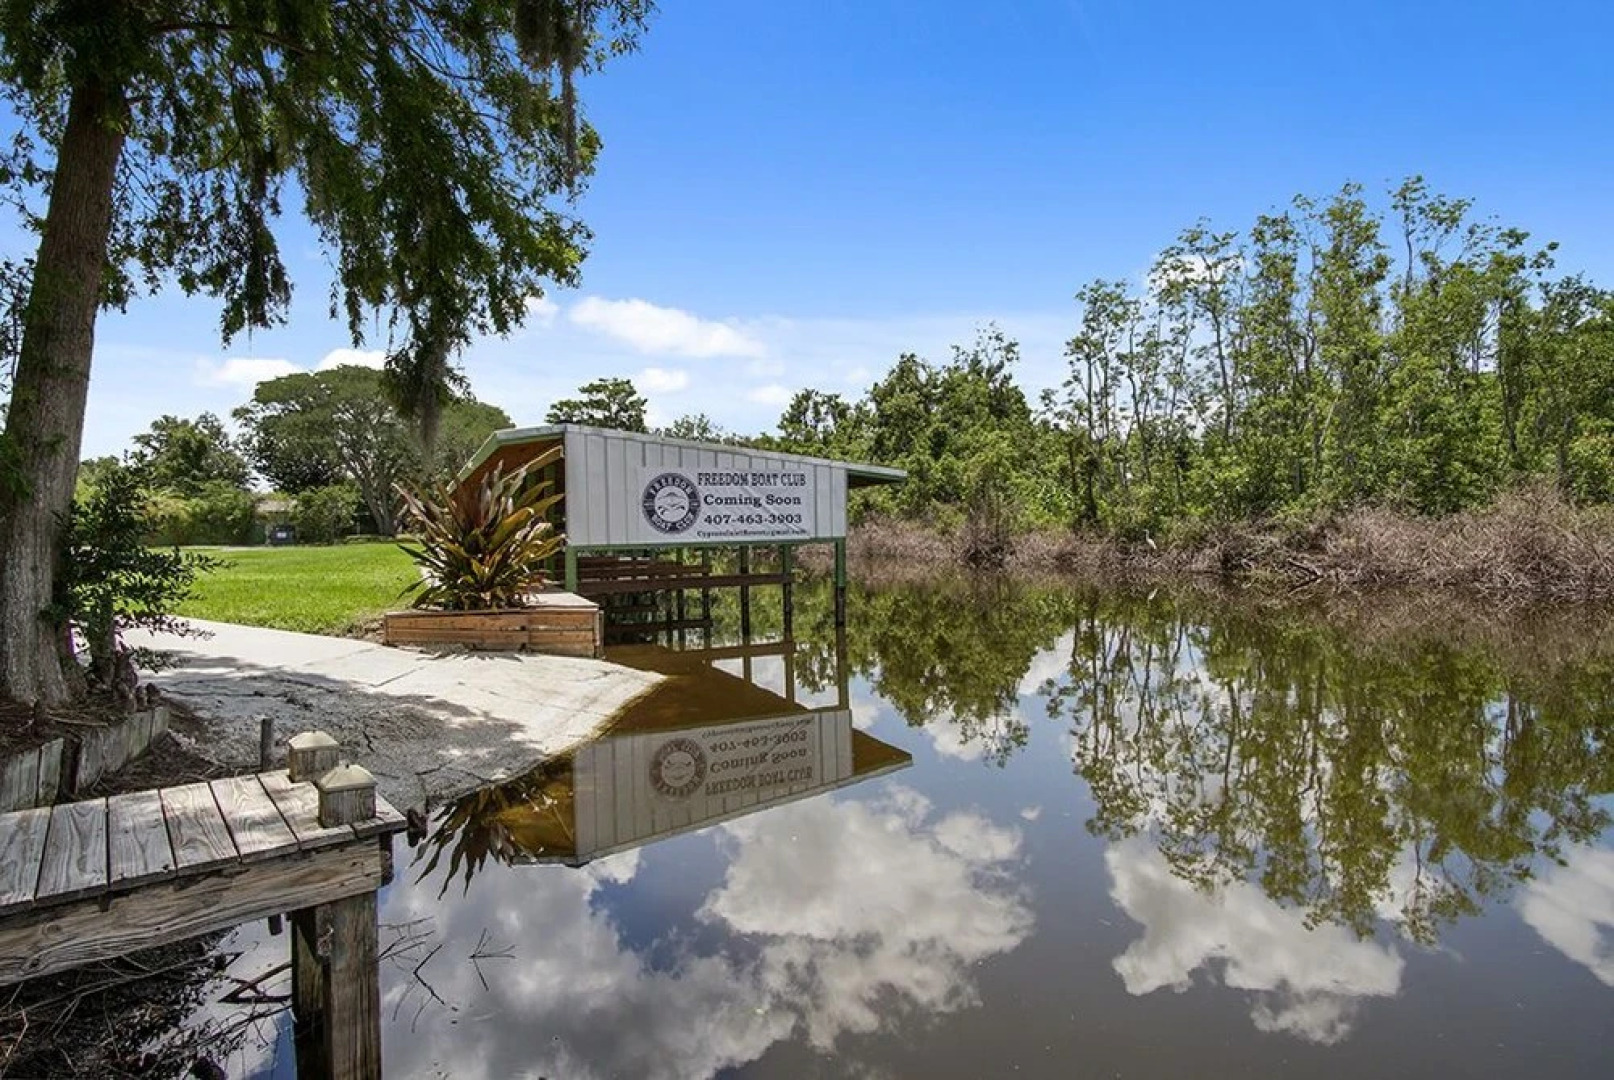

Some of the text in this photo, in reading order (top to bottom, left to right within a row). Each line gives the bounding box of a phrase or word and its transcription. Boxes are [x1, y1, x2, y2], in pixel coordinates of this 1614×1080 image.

[697, 472, 806, 487] FREEDOM BOAT CLUB
[703, 493, 802, 508] Coming Soon
